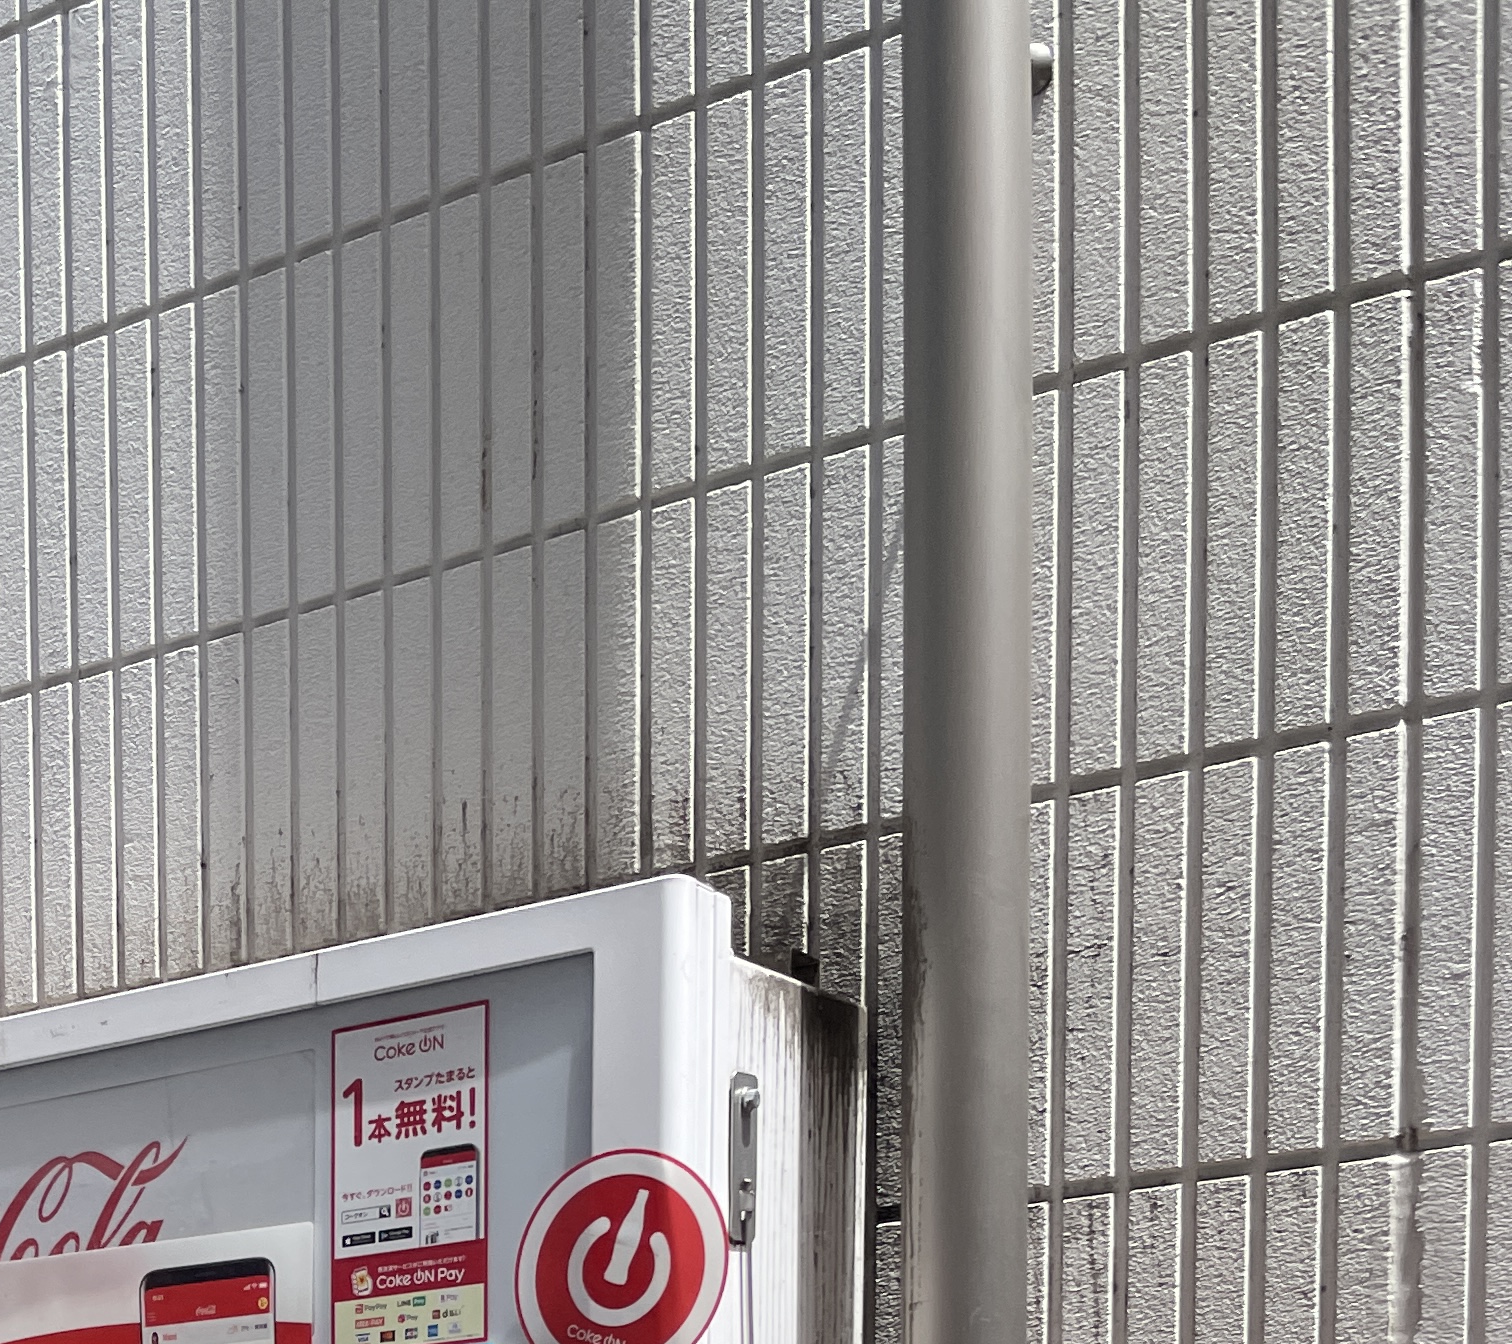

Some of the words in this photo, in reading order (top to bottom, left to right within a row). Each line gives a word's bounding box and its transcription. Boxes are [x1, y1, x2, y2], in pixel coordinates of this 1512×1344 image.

[374, 1042, 415, 1061] Coke
[419, 1034, 444, 1052] ON
[394, 1066, 476, 1092] スタンプたまると
[343, 1078, 476, 1147] 1本無料!
[376, 1274, 412, 1289] Coke
[413, 1269, 434, 1284] ON
[438, 1267, 465, 1283] Pay
[567, 1324, 602, 1344] Coke
